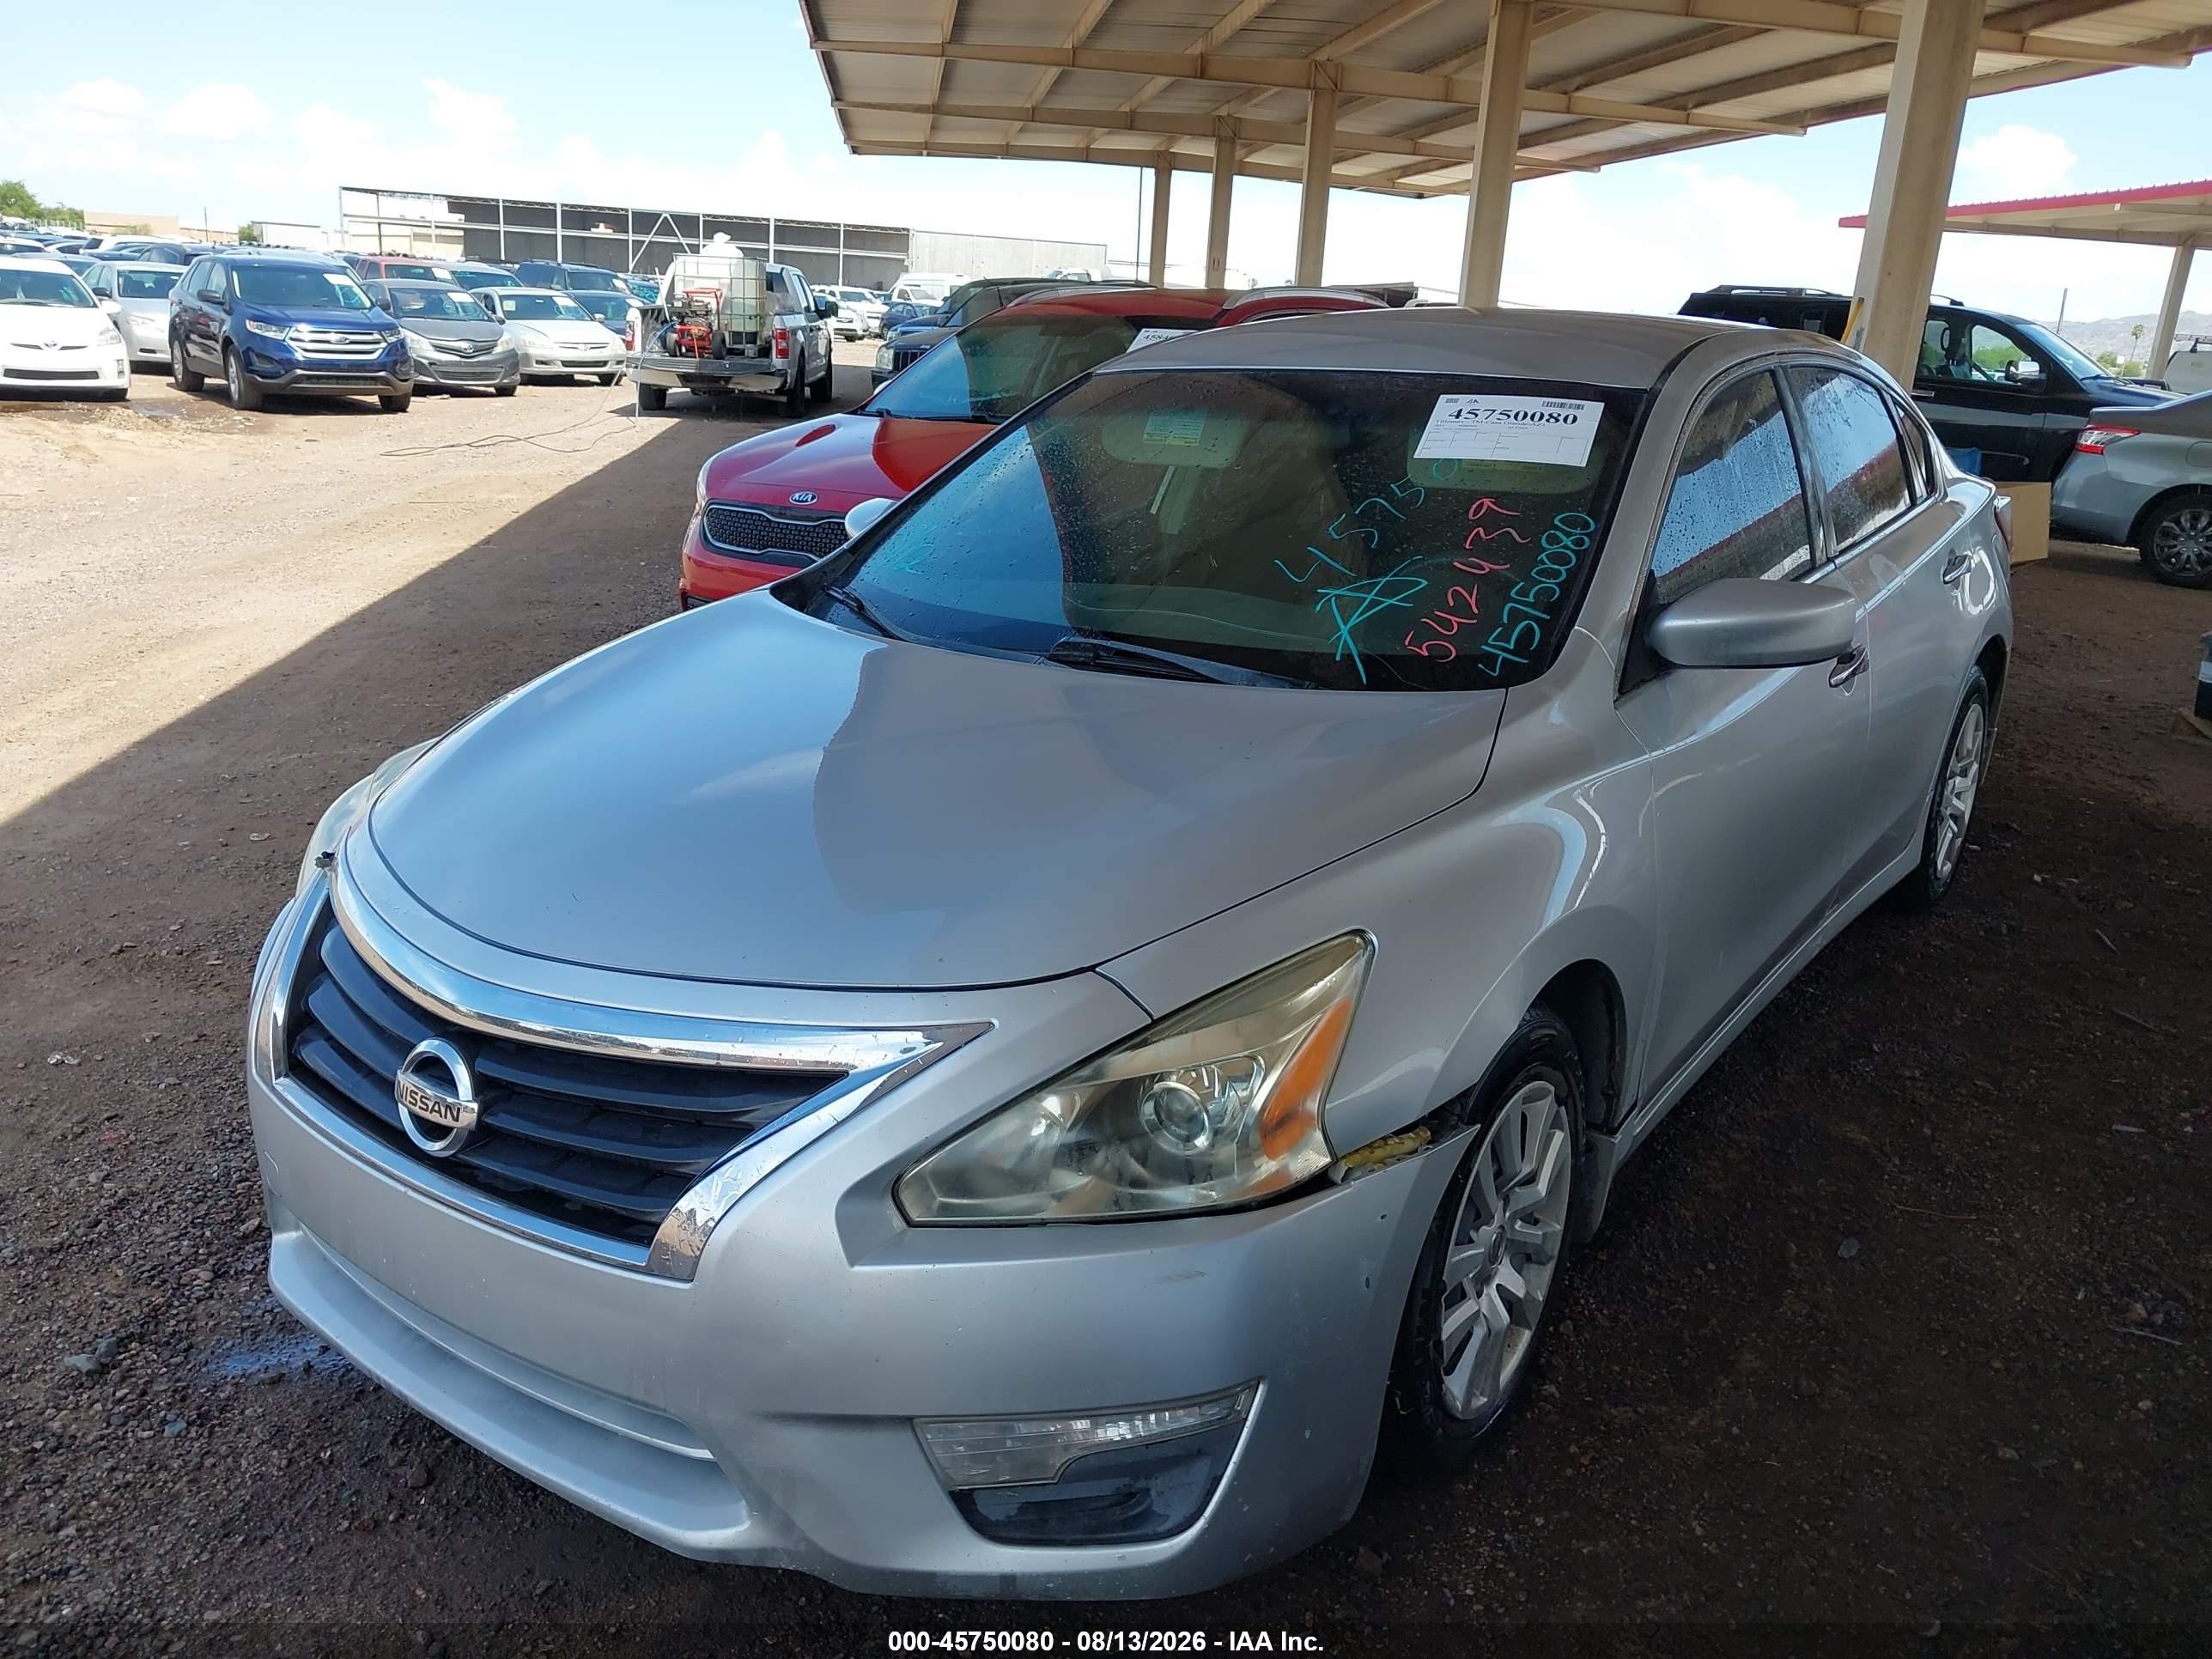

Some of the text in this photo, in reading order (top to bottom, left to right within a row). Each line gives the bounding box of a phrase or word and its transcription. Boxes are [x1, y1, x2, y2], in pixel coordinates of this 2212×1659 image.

[1448, 408, 1578, 426] 45750080
[793, 492, 813, 501] KIA
[1404, 497, 1532, 662] 542439
[1478, 513, 1595, 676] 45750080
[397, 1079, 461, 1123] NISSAN
